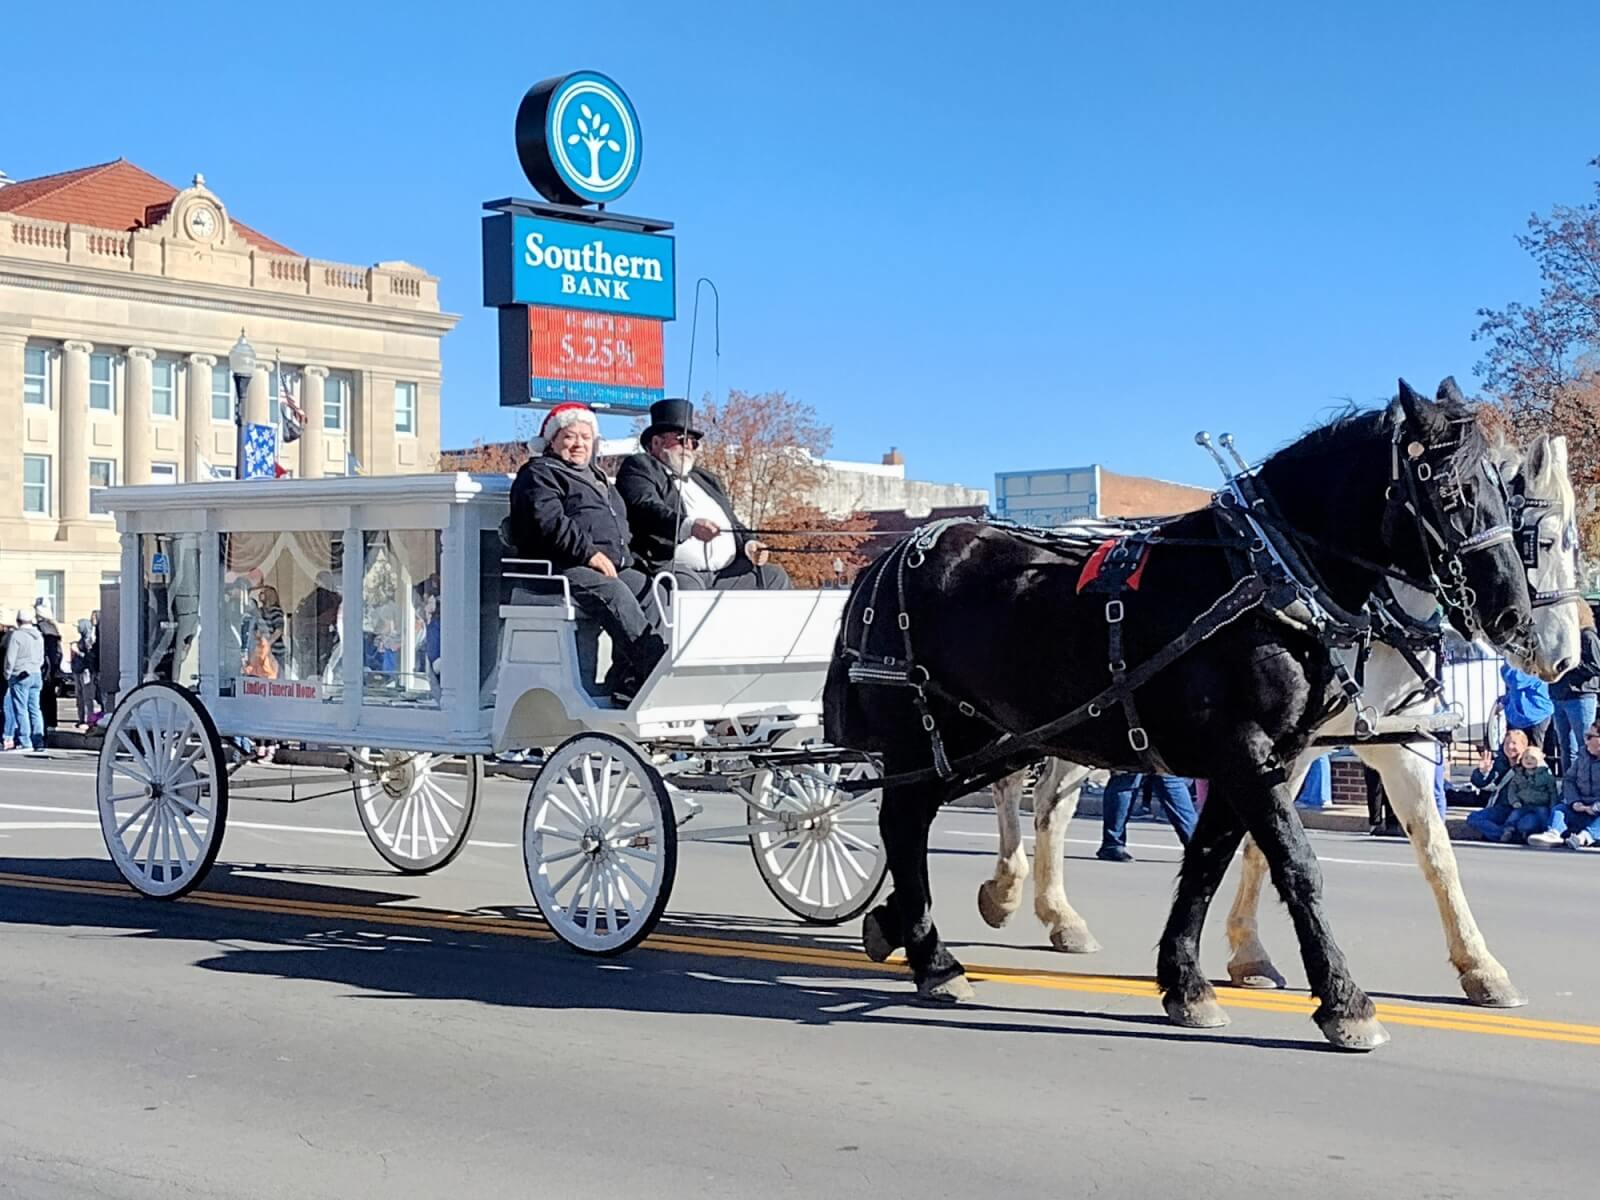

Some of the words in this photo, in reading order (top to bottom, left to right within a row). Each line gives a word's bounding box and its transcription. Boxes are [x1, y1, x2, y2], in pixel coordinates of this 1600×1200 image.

[525, 232, 663, 281] Southern
[561, 274, 630, 300] BANK
[560, 334, 636, 368] 5.25%
[269, 682, 294, 697] Funeral
[296, 683, 316, 698] Home
